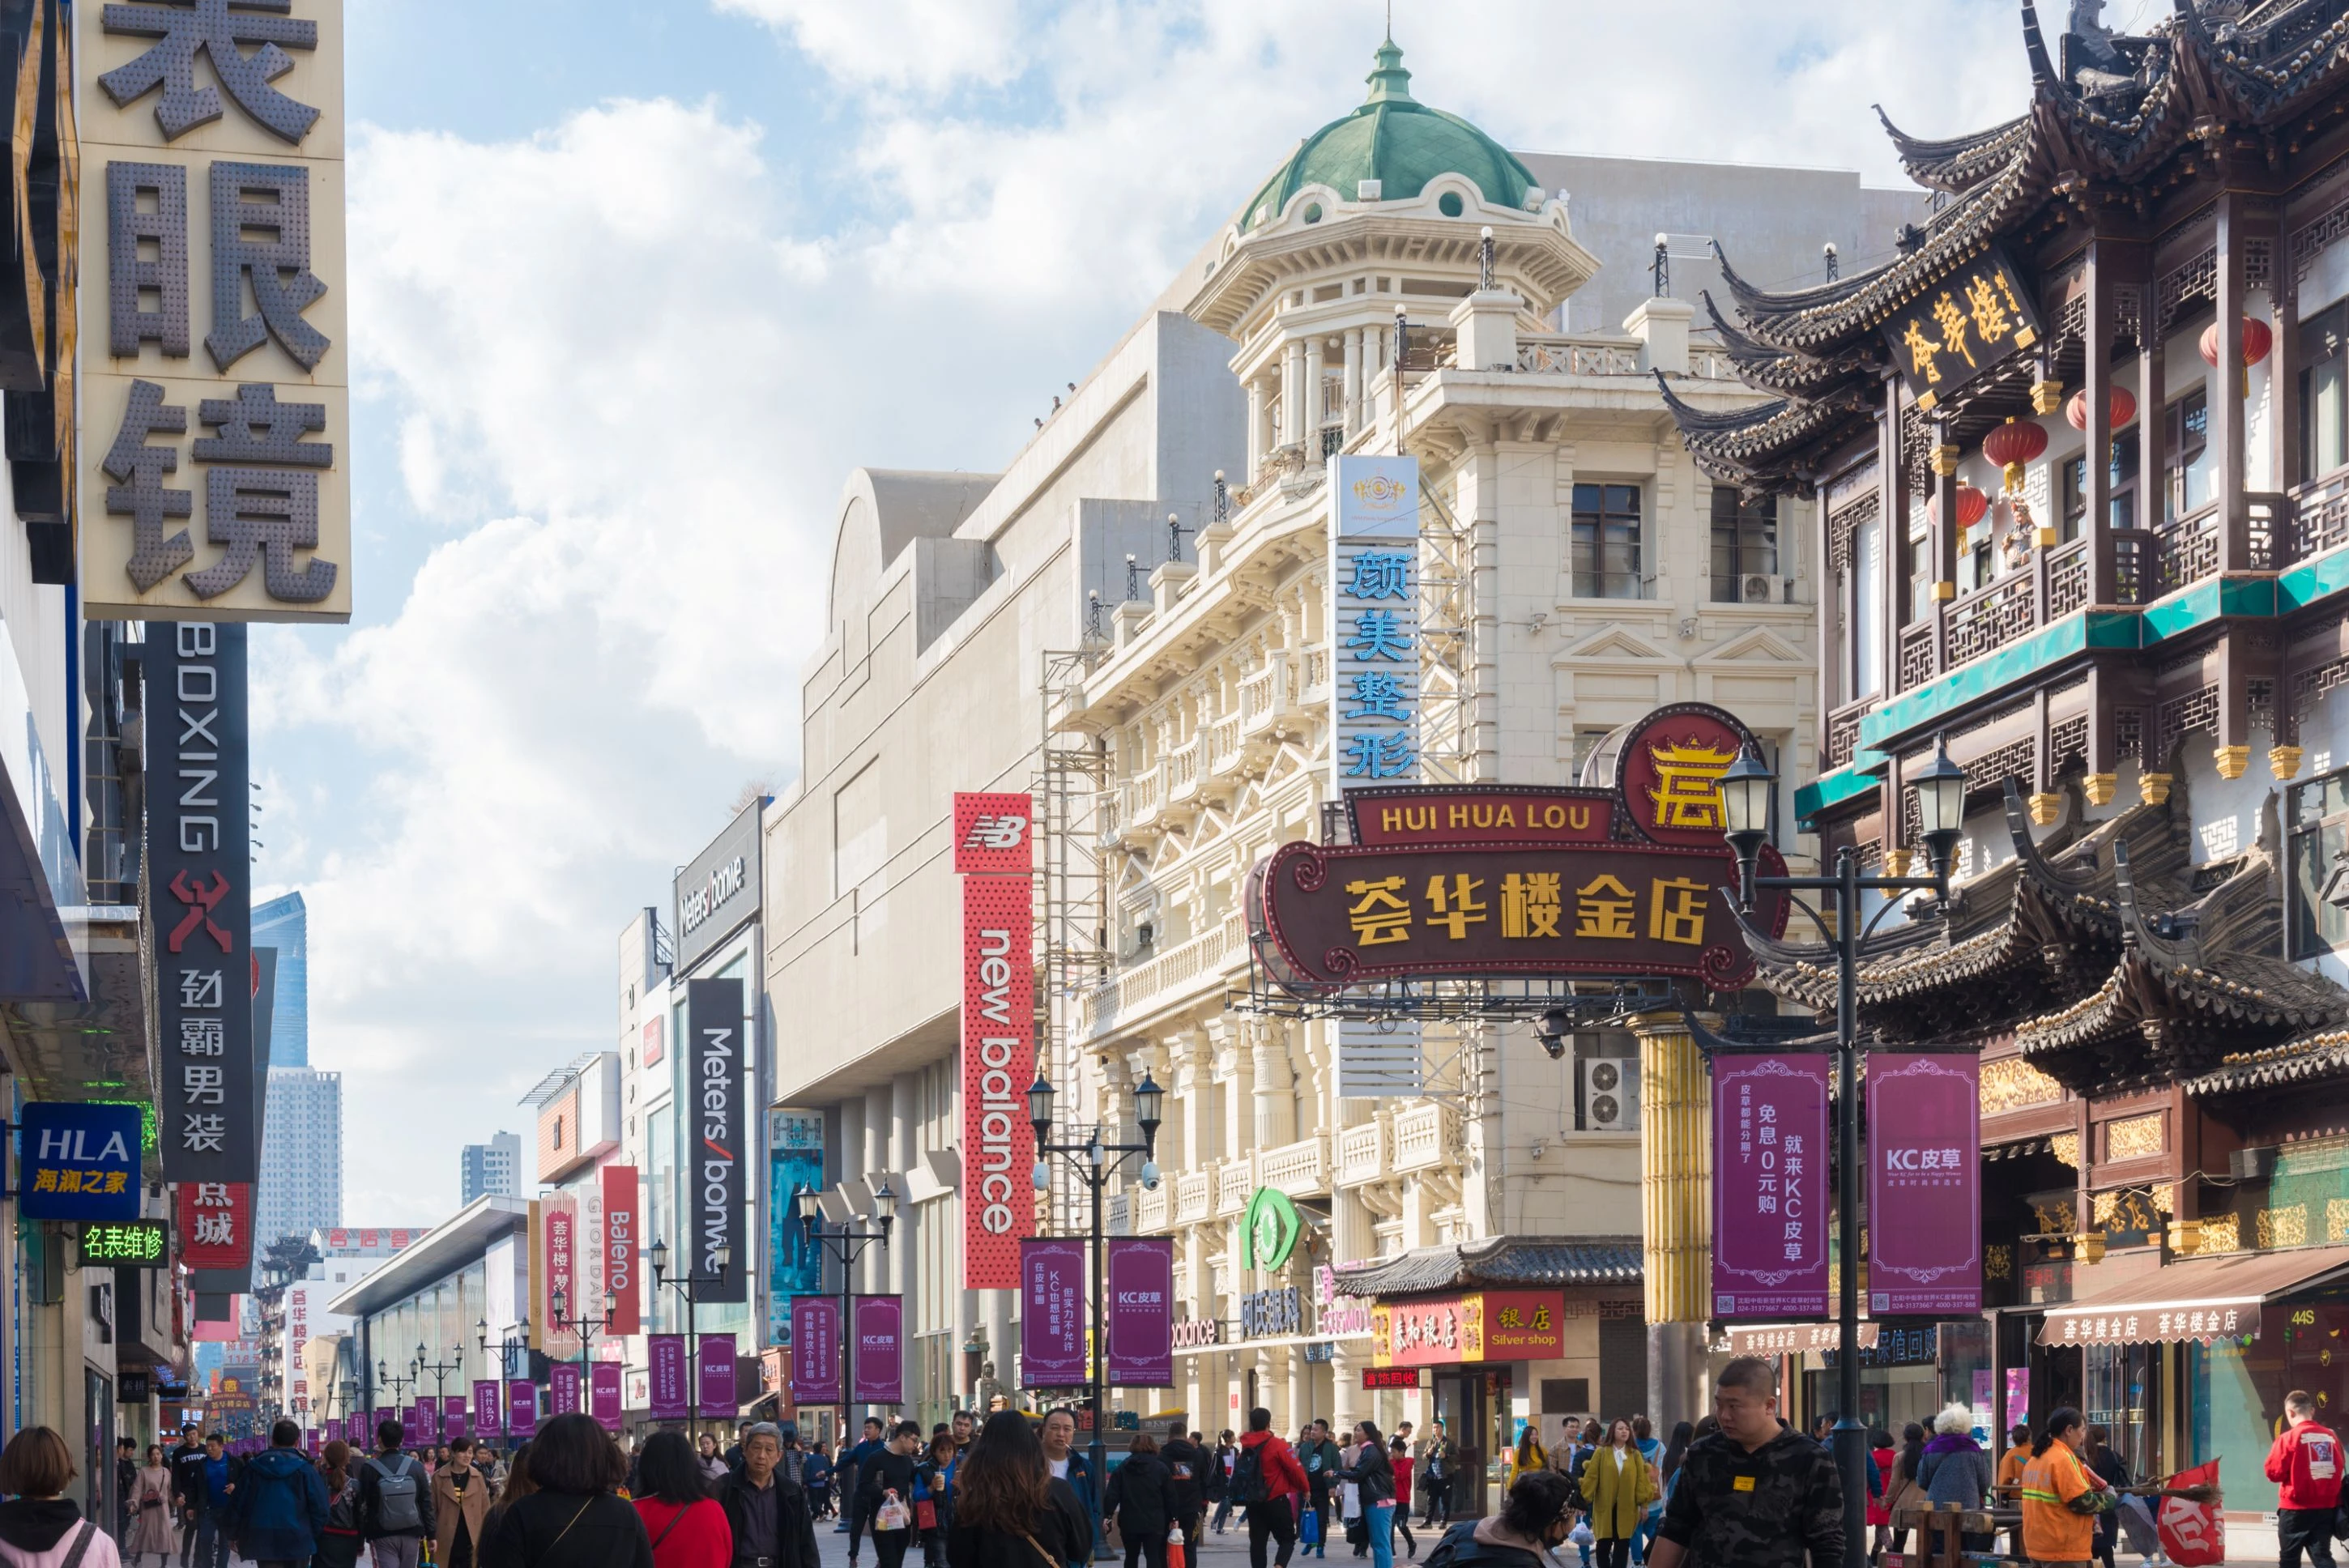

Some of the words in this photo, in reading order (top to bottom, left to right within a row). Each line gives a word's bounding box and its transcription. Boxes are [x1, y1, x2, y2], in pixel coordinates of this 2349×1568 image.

[1345, 550, 1414, 778] 颜美整形
[177, 621, 219, 852] BOXING
[1383, 806, 1436, 832] HUI
[1449, 804, 1516, 829] HUA
[1527, 804, 1590, 829] LOU
[1345, 872, 1709, 947] 荟华楼金店
[980, 929, 1011, 1024] new
[180, 969, 225, 1152] 劲霸男装
[982, 1038, 1013, 1234] balance
[1741, 1084, 1751, 1164] 皮草都能分期了
[39, 1129, 130, 1162] HLA
[1759, 1105, 1777, 1213] 免息0元购
[1886, 1148, 1961, 1170] KC皮草
[32, 1169, 128, 1195] 海澜之家
[1784, 1135, 1803, 1261] 就来KC皮草
[84, 1225, 163, 1259] 名表维修
[610, 1211, 633, 1290] Baleno
[1050, 1271, 1060, 1336] KC也想低调
[1119, 1291, 1162, 1304] KC皮草
[1064, 1288, 1074, 1352] 但实力不允许
[1393, 1309, 1457, 1353] 泰和银店
[1498, 1304, 1553, 1332] 银店
[2064, 1315, 2138, 1339] 荟华楼金店
[2159, 1309, 2237, 1334] 荟华楼金店
[863, 1336, 894, 1344] KC皮草
[1491, 1334, 1525, 1345] Silver
[1528, 1334, 1557, 1347] shop
[1746, 1330, 1796, 1350] 荟华楼金店
[1366, 1371, 1415, 1386] 首饰回收
